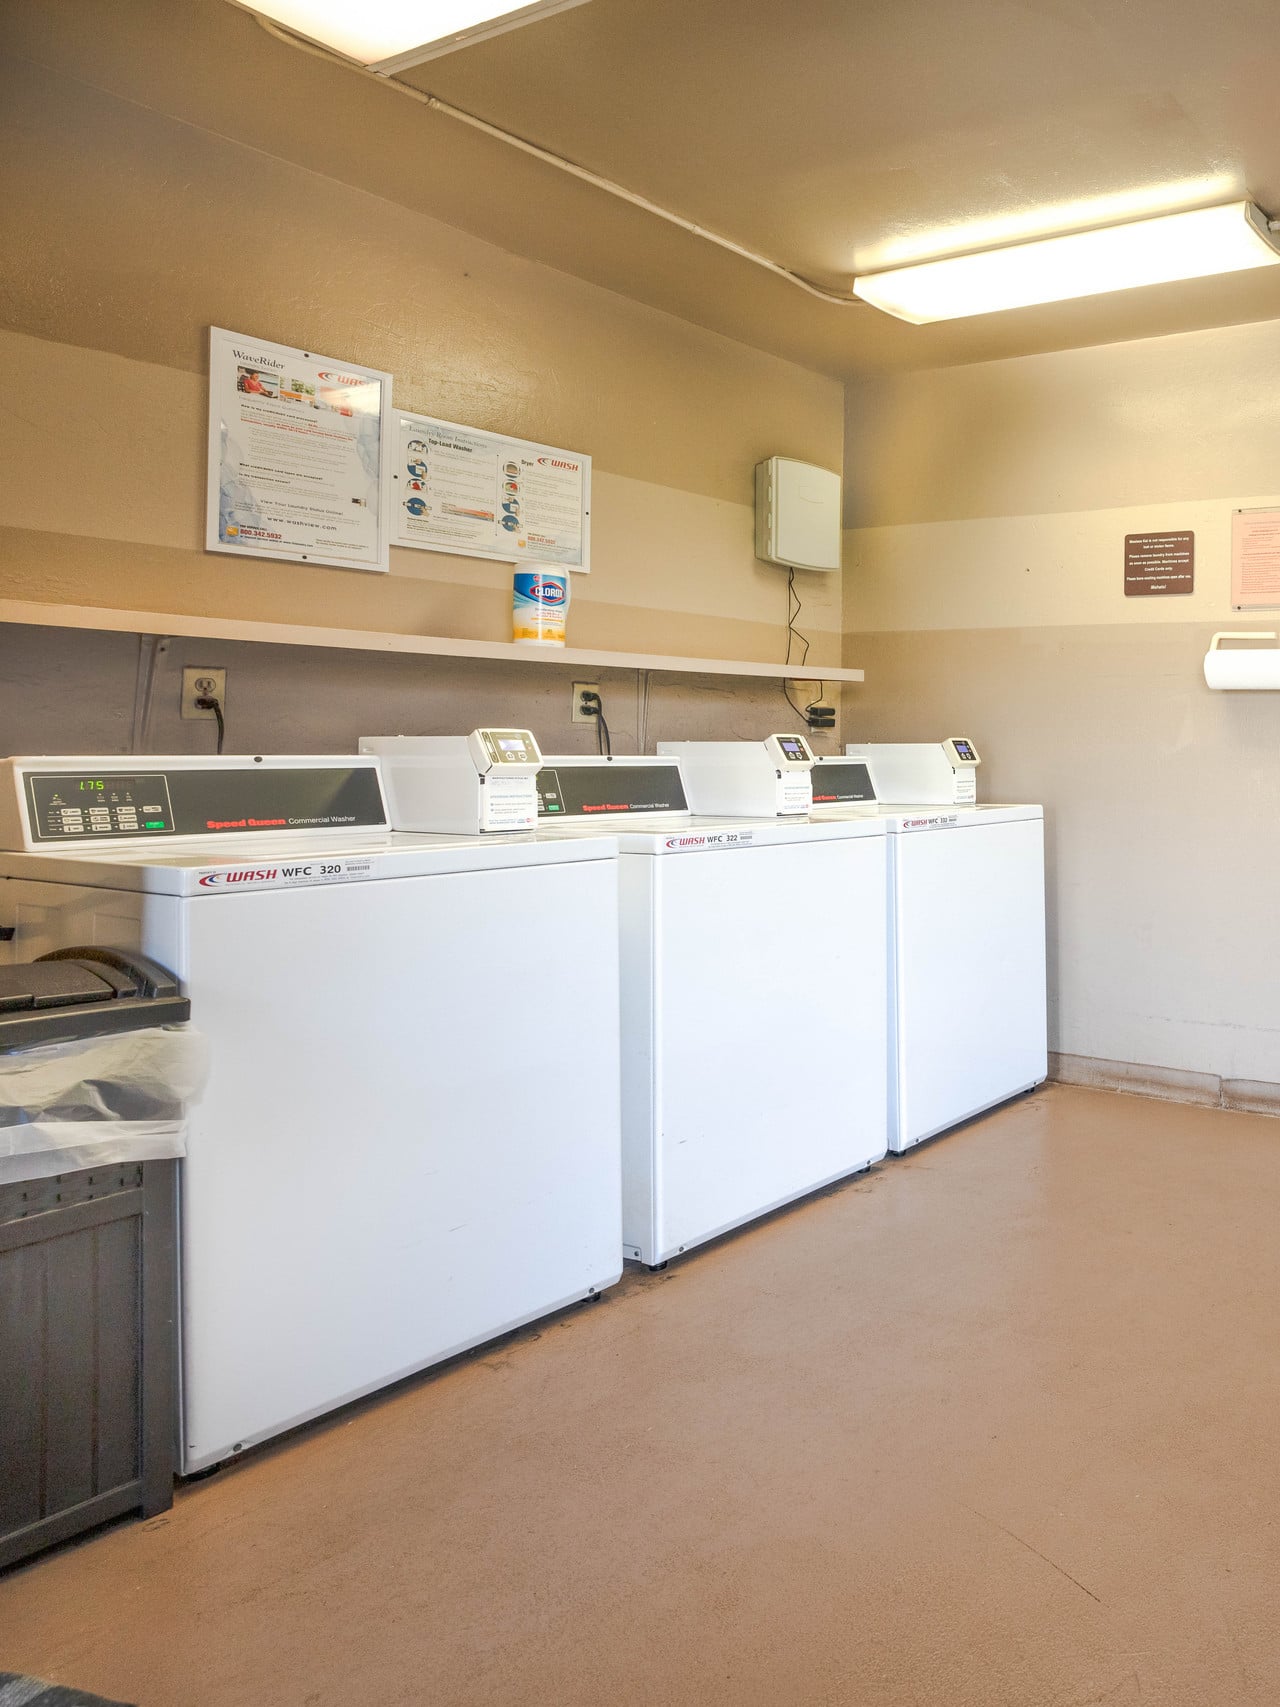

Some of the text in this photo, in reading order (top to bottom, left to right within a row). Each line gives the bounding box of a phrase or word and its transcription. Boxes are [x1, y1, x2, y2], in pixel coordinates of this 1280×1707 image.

[233, 350, 285, 369] WaveRider
[337, 376, 367, 387] WAS
[551, 459, 578, 471] WASH
[583, 804, 606, 812] Speed
[207, 819, 246, 829] Speed
[248, 818, 286, 826] Queen
[288, 817, 330, 825] Commercial
[679, 837, 705, 845] WASH
[226, 869, 277, 882] WASH
[282, 866, 312, 877] WFC
[320, 865, 341, 874] 320
